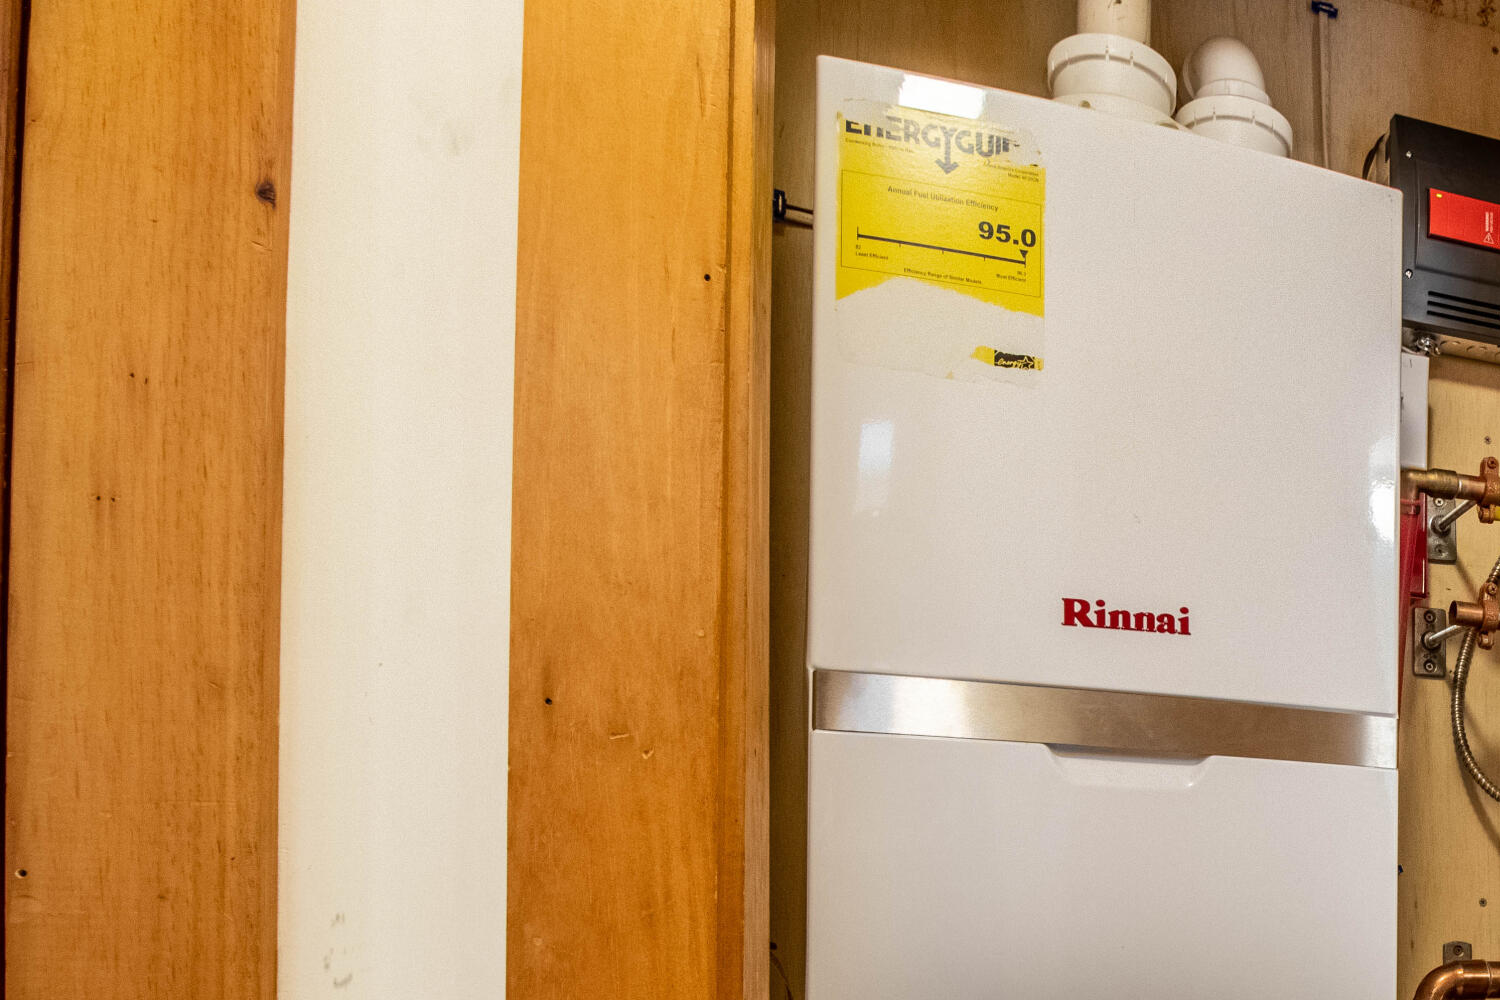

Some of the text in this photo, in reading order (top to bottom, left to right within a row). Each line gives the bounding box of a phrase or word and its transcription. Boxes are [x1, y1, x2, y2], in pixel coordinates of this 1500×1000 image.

[887, 185, 999, 212] Annual Fuel Utilization Efficiency
[978, 221, 1036, 247] 95.0
[1061, 597, 1191, 635] Rinnai
